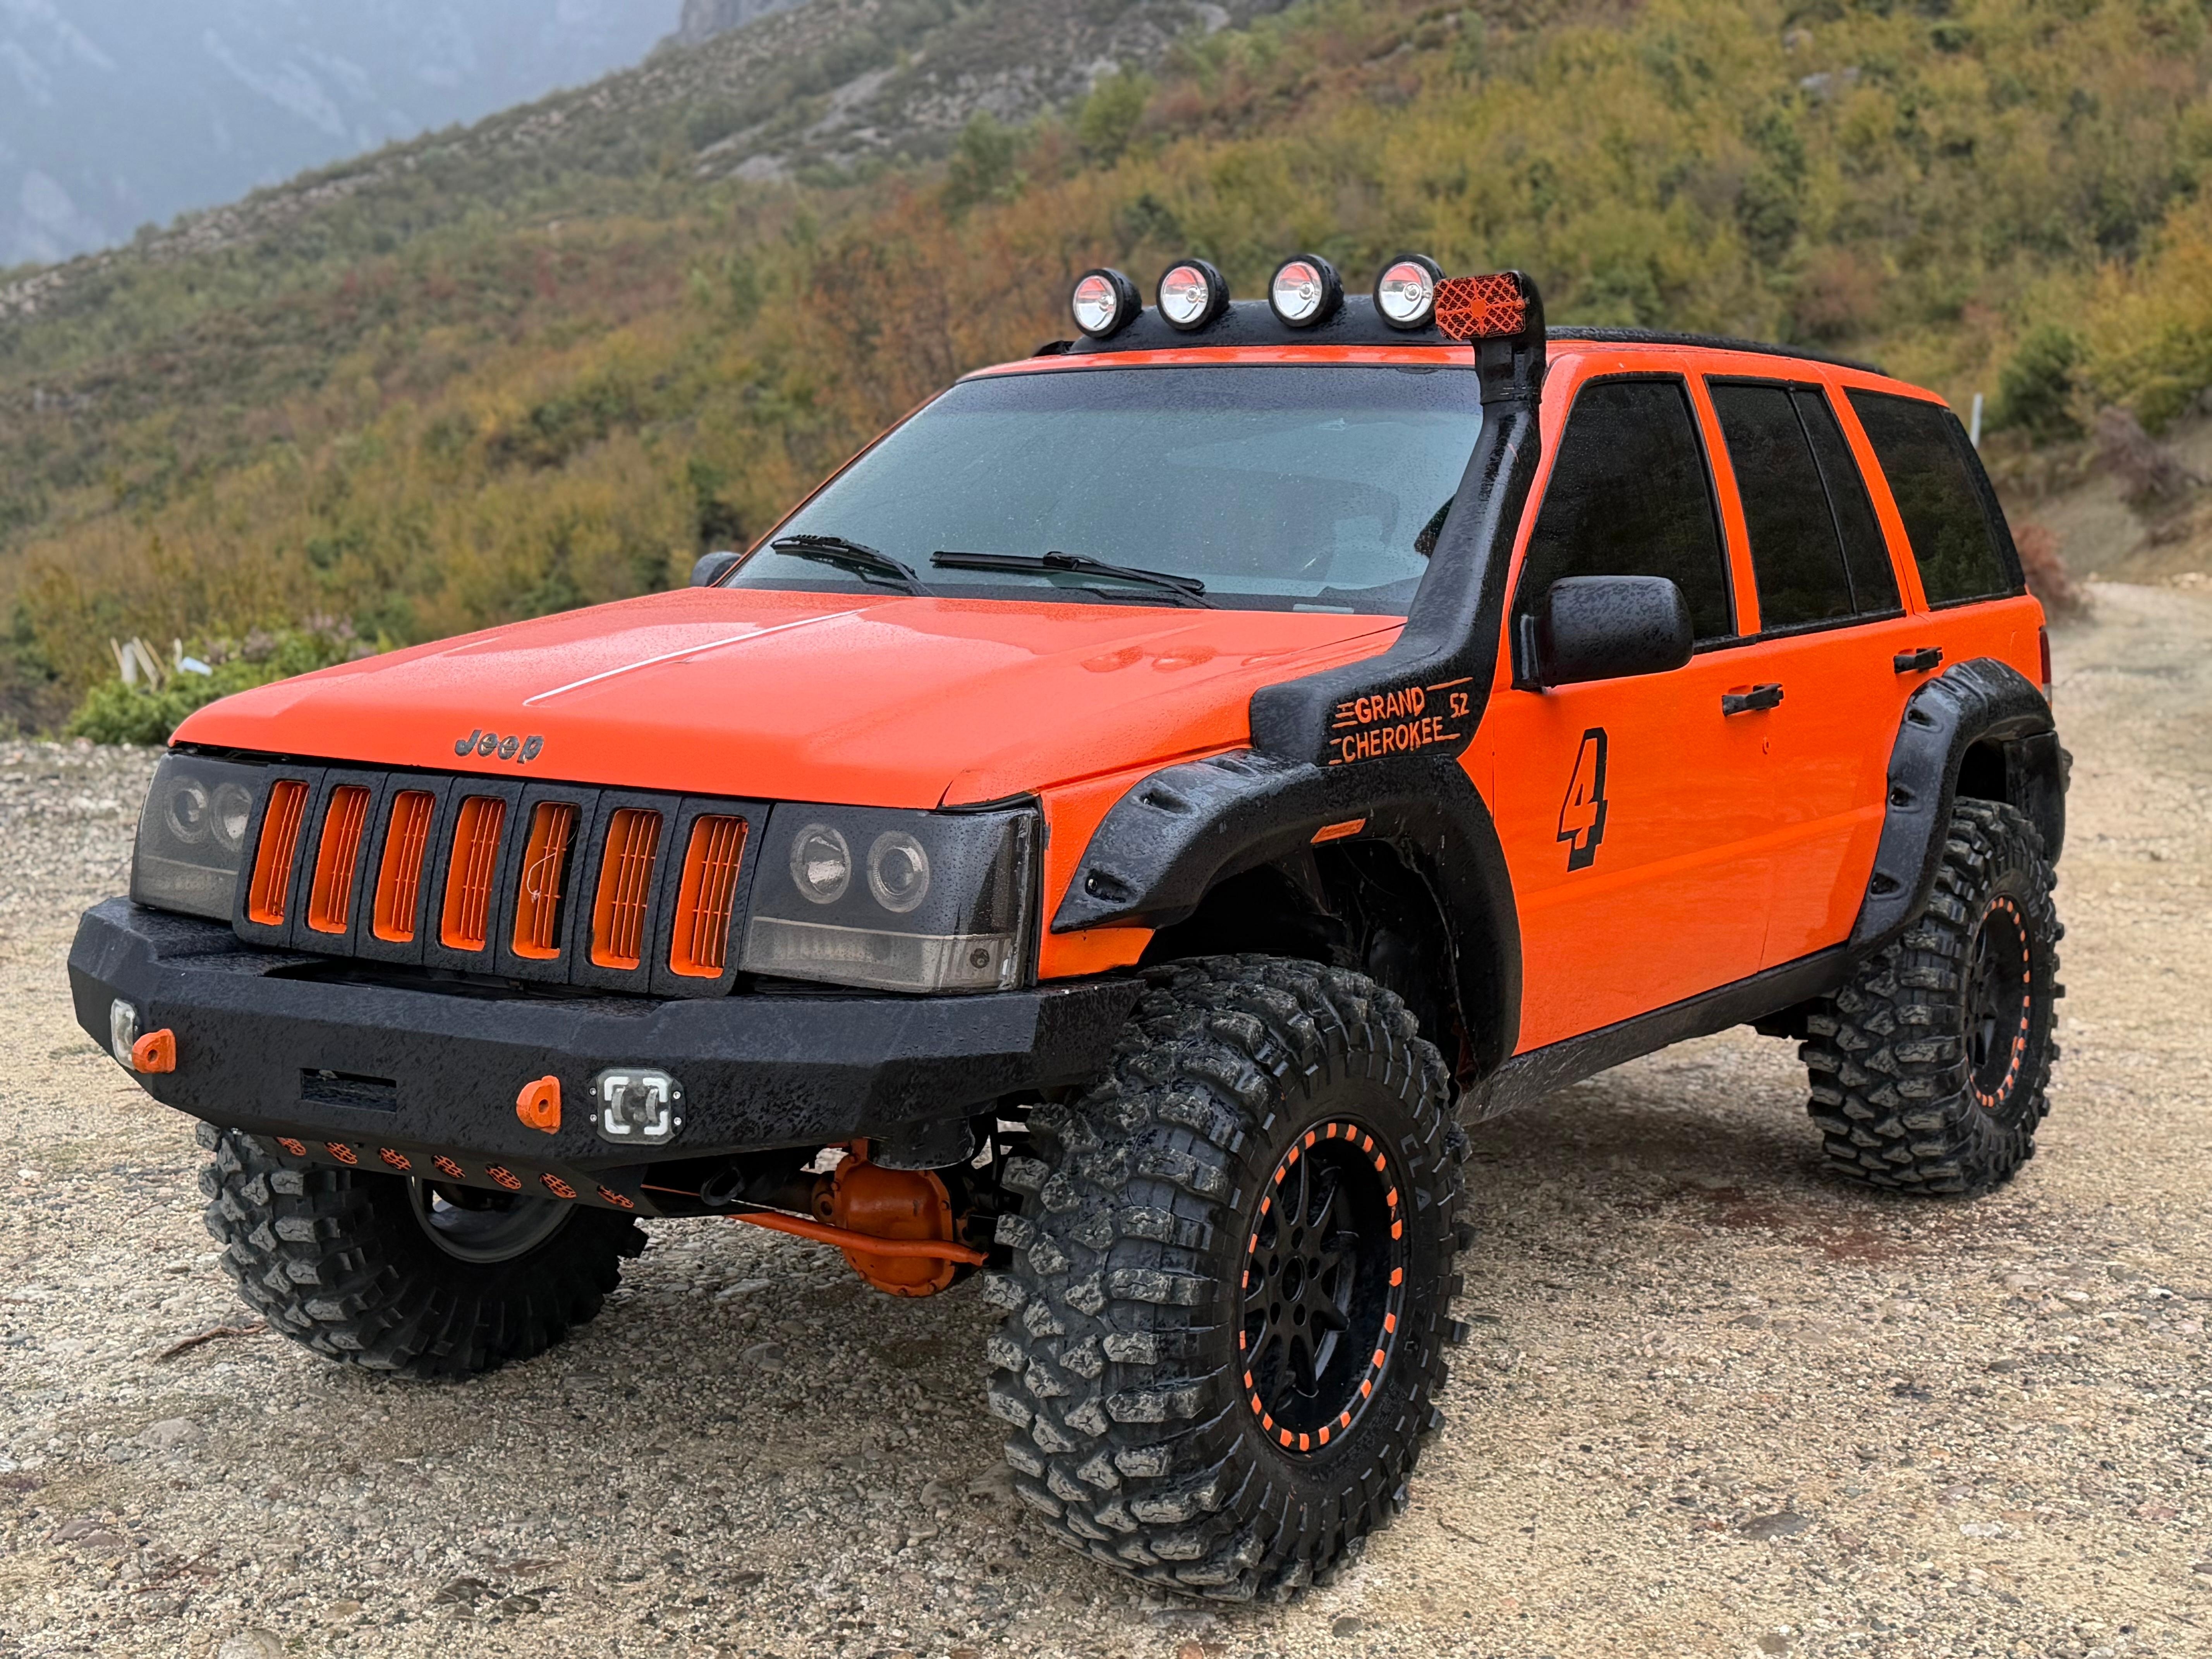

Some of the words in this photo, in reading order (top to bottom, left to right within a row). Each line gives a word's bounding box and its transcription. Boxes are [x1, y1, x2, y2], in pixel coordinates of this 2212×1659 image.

[1355, 686, 1425, 723] GRAND
[454, 729, 544, 764] Jeep
[1342, 716, 1444, 763] CHEROKEE
[1556, 726, 1608, 872] 4
